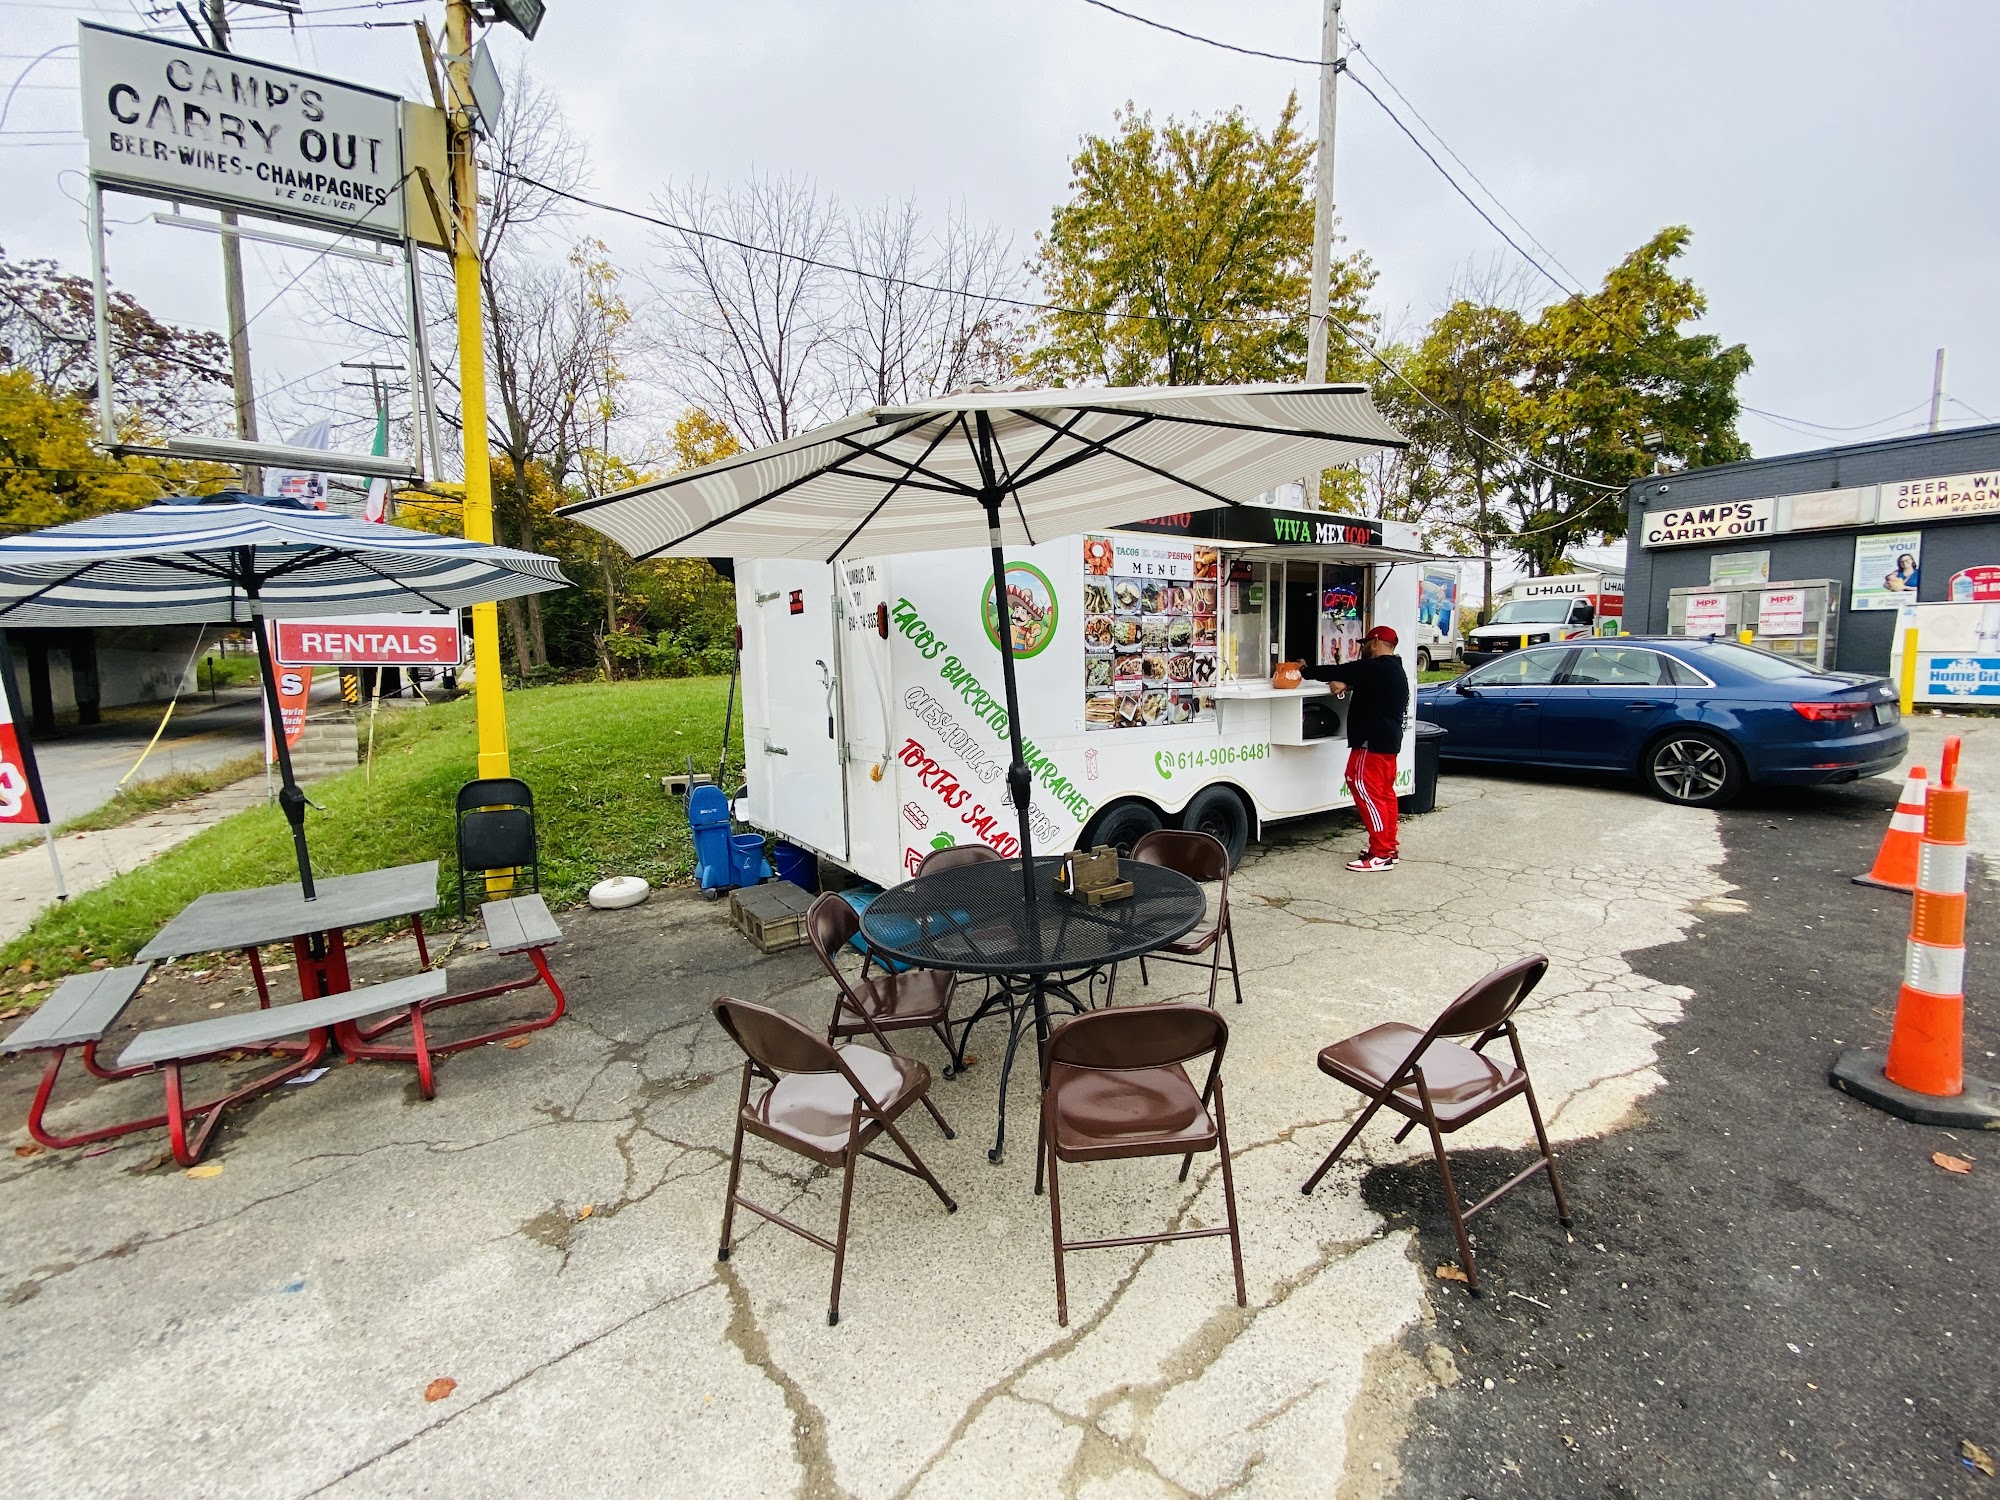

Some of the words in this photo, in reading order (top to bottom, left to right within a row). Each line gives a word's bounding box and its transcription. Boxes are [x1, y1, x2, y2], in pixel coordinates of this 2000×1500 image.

[165, 58, 325, 123] CAMP'S
[107, 82, 282, 155] CARRY
[299, 128, 384, 175] OUT
[302, 191, 357, 213] DELIVER
[1899, 481, 1949, 497] BEER
[1663, 503, 1754, 528] CAMP'S
[1951, 504, 1969, 513] WE
[1272, 517, 1312, 543] VIVA
[1315, 521, 1371, 546] MEXICO!
[1648, 524, 1723, 543] CARRY
[1727, 517, 1769, 535] OUT
[1115, 546, 1140, 557] TACOS
[1860, 537, 1899, 546] Medicaid
[1860, 544, 1888, 552] Around
[1889, 542, 1917, 552] YOU!
[1132, 562, 1177, 576] MENU
[1324, 593, 1358, 608] OPEN
[1526, 583, 1586, 596] U-HAUL
[1771, 595, 1795, 603] MPP
[1696, 599, 1718, 607] MPP
[891, 597, 948, 660] TACOS
[301, 632, 438, 655] RENTALS
[1930, 671, 1976, 682] Home
[940, 655, 1012, 741] BURRITOS
[904, 685, 1004, 784] QUESADILLAS
[1177, 741, 1271, 770] 614-906-6481
[897, 737, 973, 809] TORTAS
[960, 804, 1023, 859] SALAD
